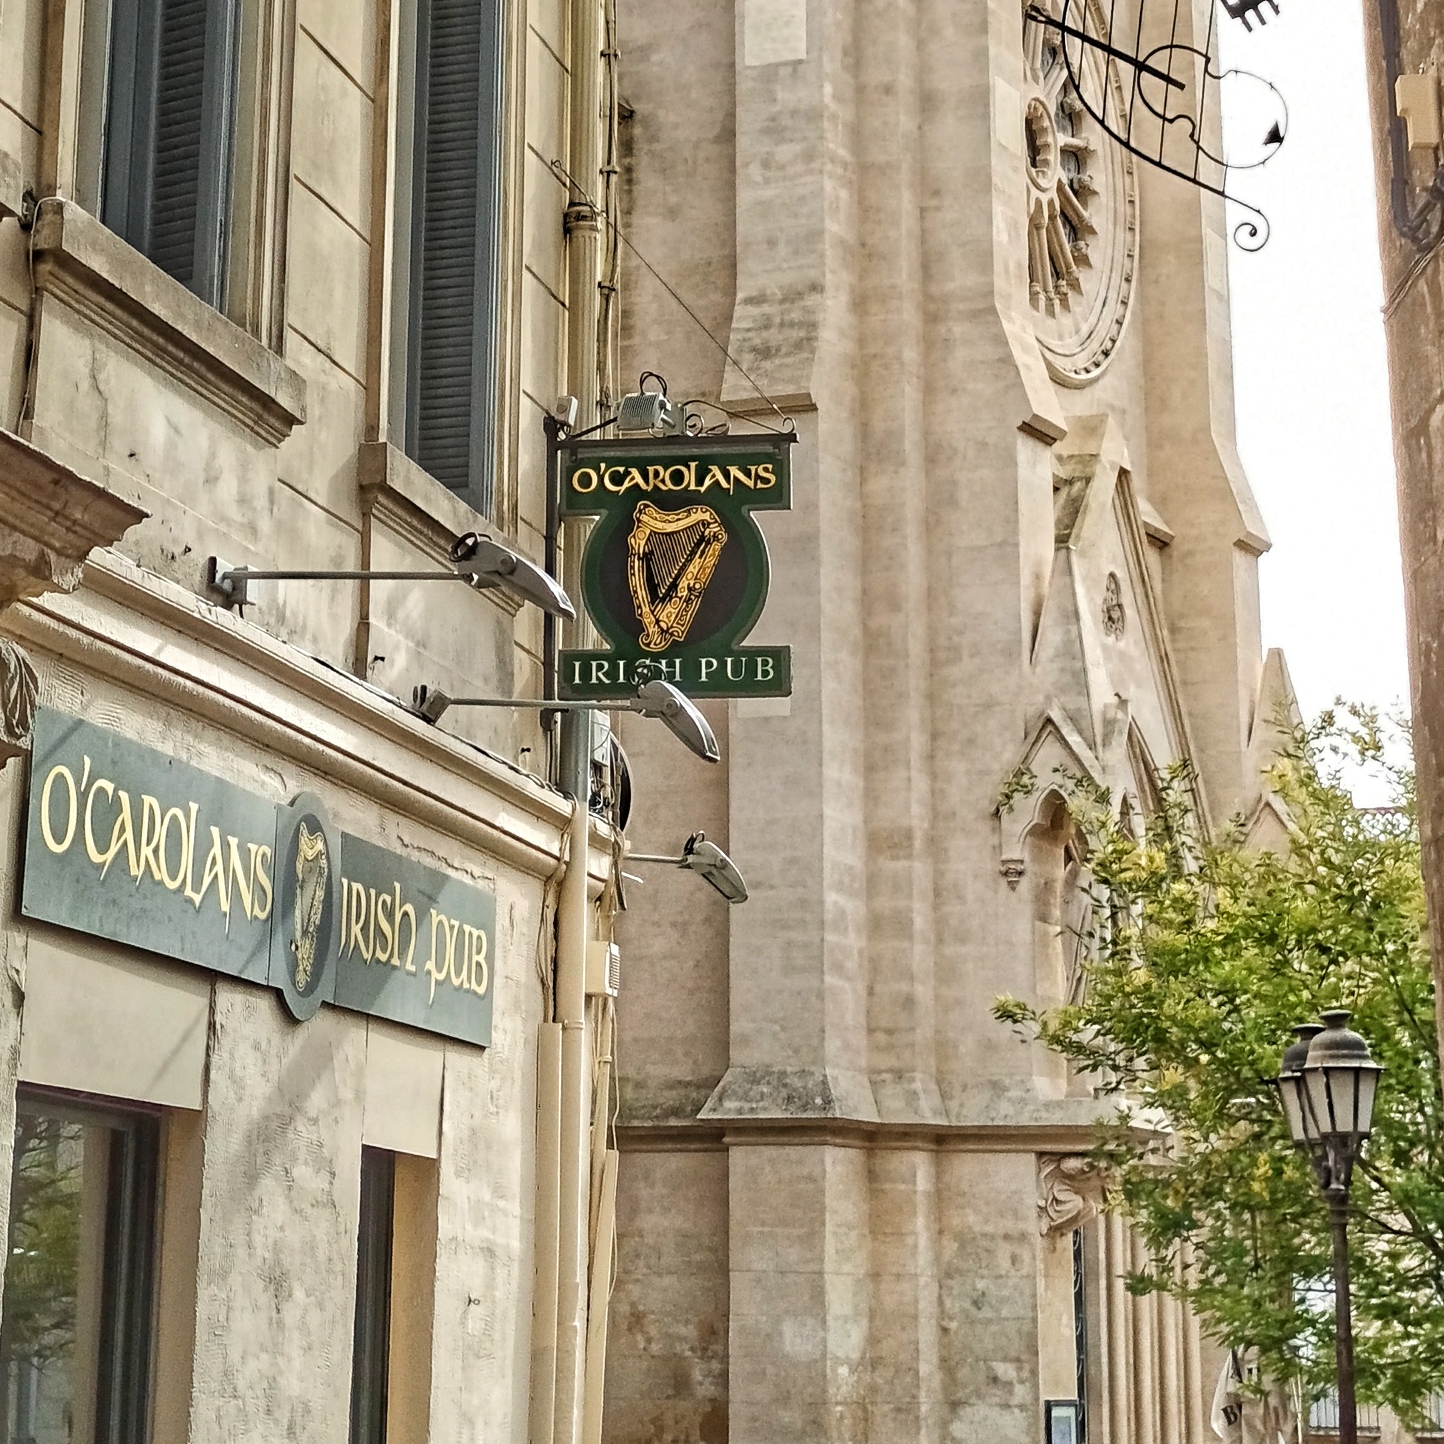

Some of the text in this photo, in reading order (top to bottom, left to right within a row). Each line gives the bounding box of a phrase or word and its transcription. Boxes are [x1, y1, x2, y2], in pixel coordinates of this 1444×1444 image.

[572, 461, 776, 495] O'CAROLANS
[698, 656, 775, 683] PUB
[41, 754, 273, 935] O'CAROLANS
